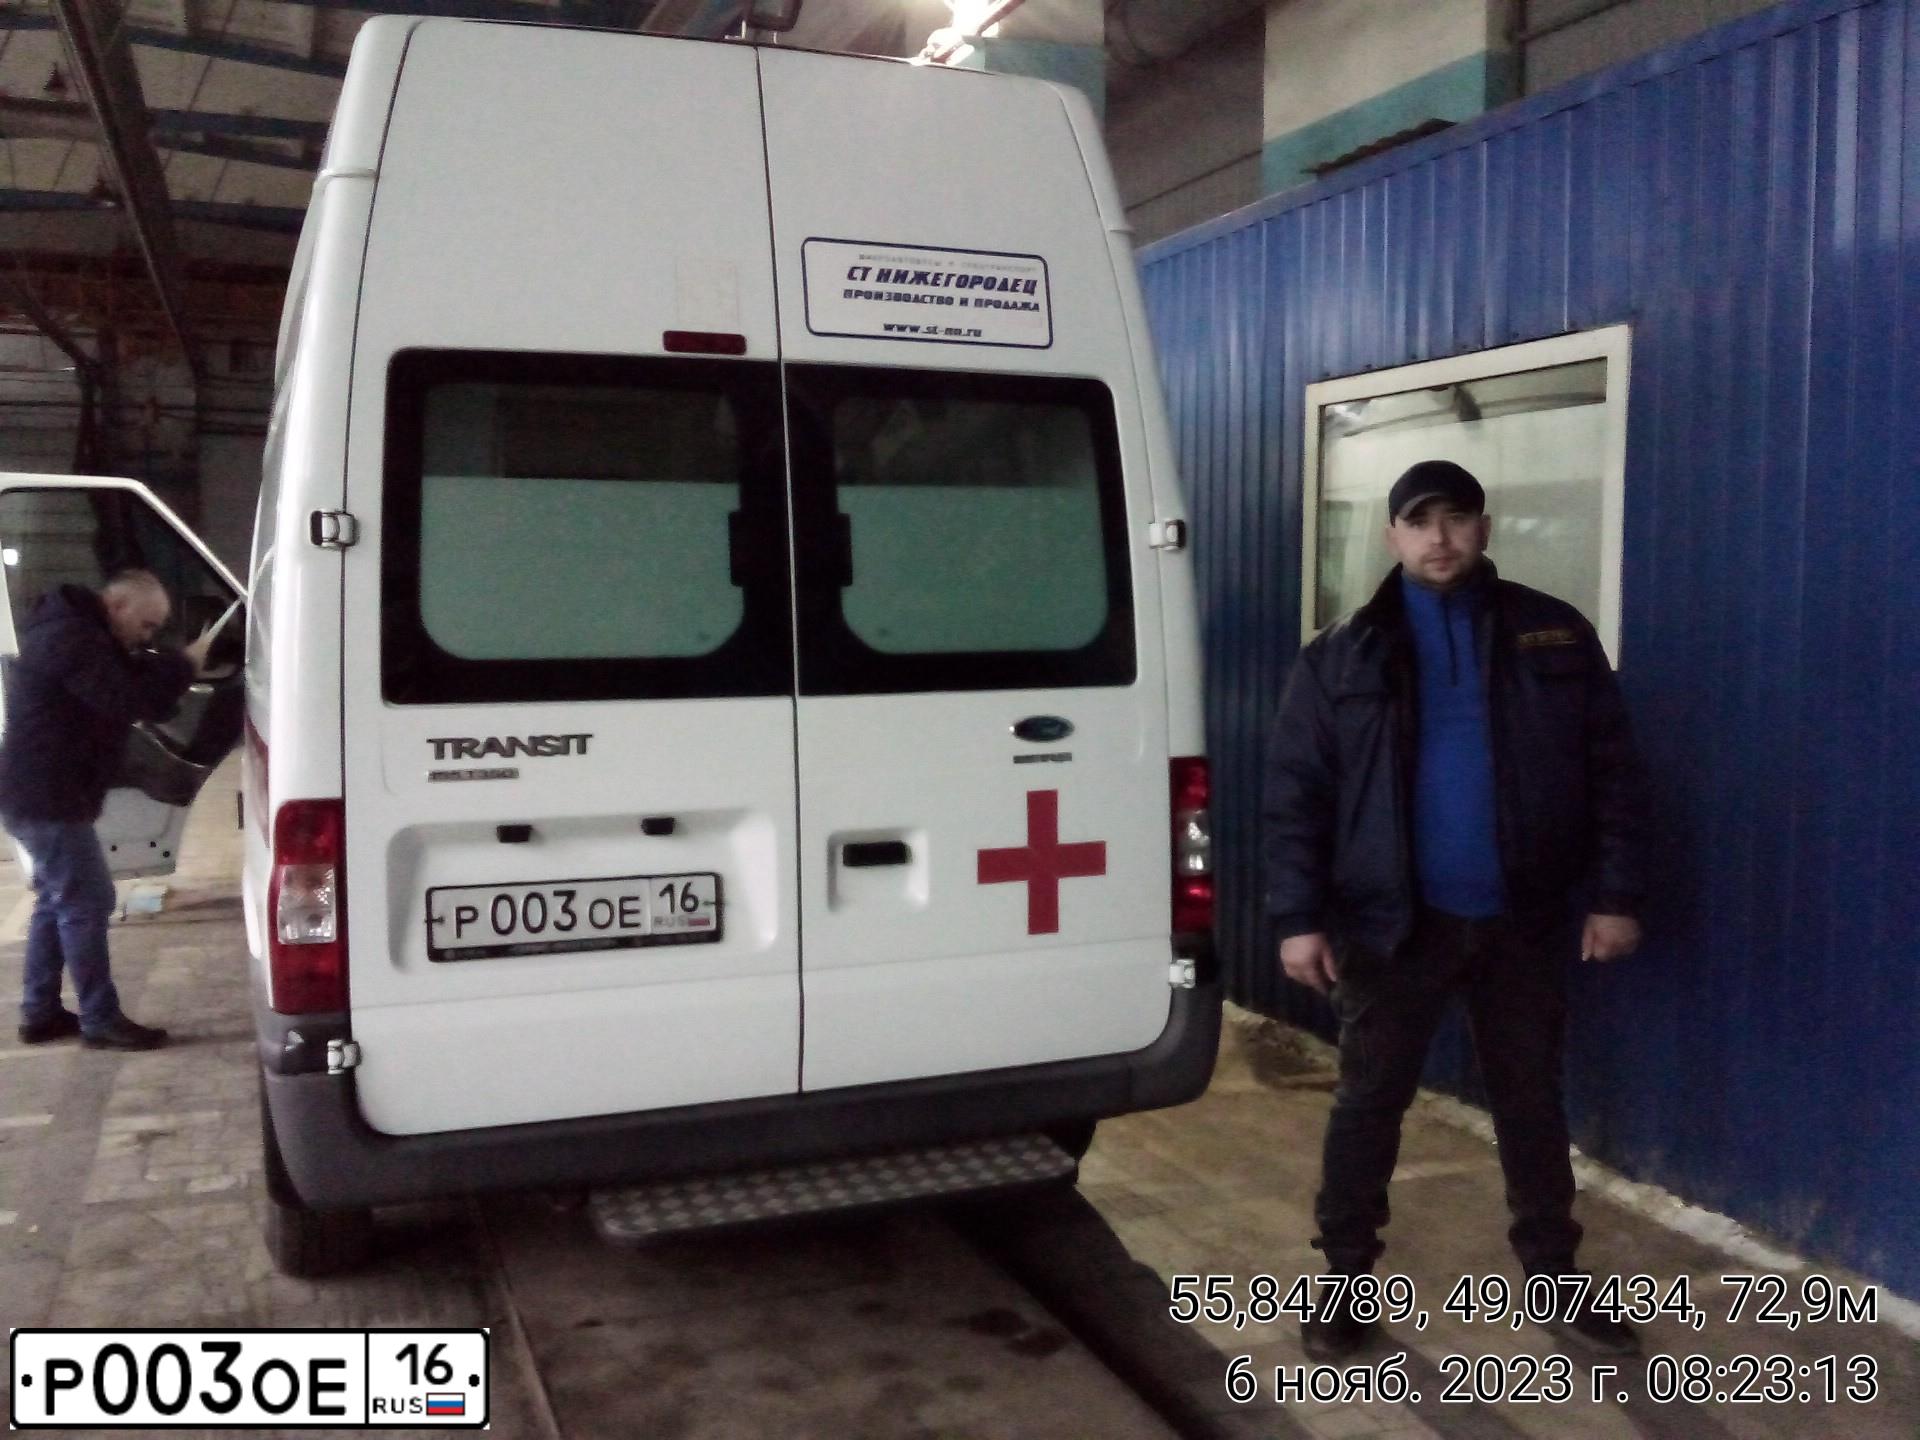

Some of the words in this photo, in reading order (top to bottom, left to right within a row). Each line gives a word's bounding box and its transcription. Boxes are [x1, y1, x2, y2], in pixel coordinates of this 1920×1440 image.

[846, 265, 872, 282] СТ
[875, 267, 1038, 297] НИЖЕГОРОДЕЦ
[843, 288, 954, 306] ПРОИЗВОДСТВО
[959, 296, 969, 307] И
[974, 297, 1040, 313] ПРОДАЖА
[426, 733, 594, 761] TRANSIT
[658, 881, 700, 914] 16
